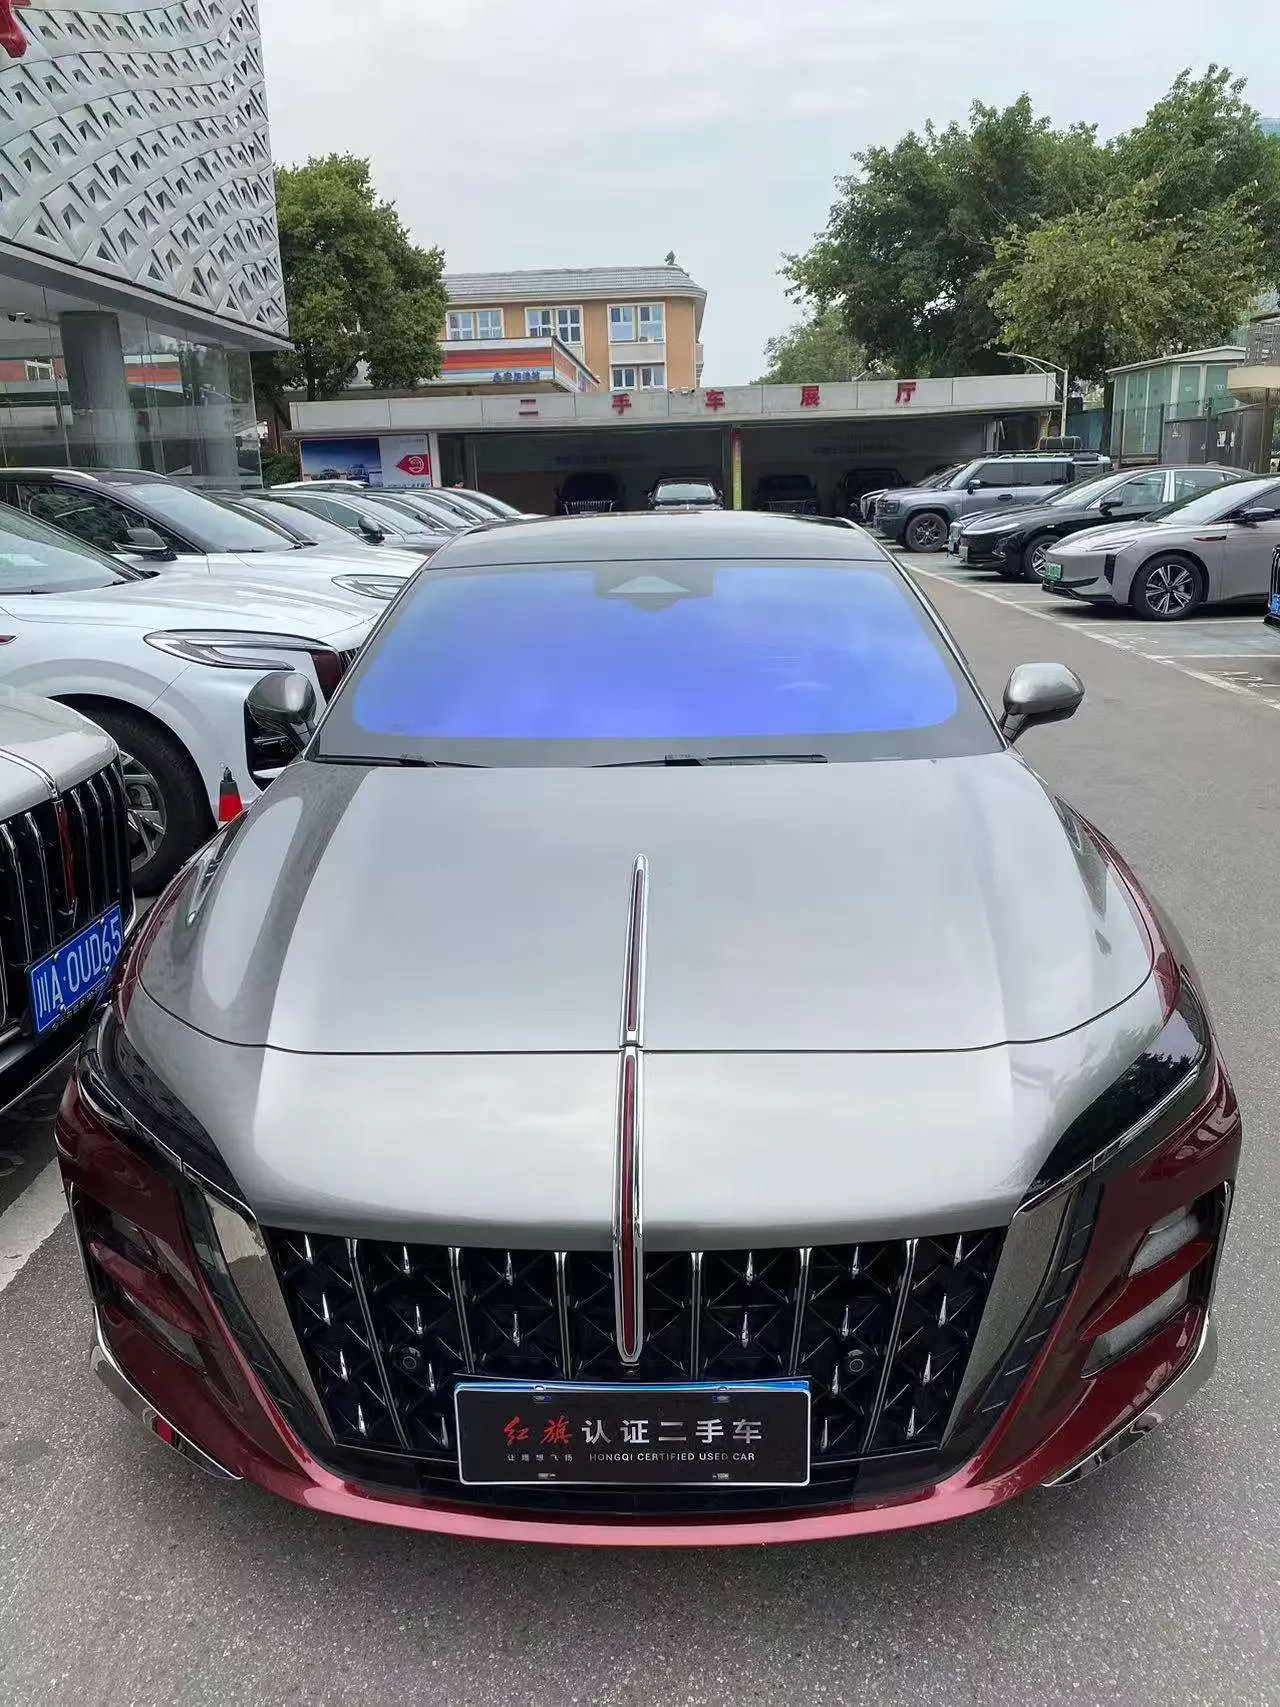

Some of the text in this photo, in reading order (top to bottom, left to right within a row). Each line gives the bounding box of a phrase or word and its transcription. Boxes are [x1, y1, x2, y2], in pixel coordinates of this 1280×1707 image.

[518, 382, 917, 416] 二手车展厅
[589, 1452, 755, 1462] HONGQI CERTIFIED USED CAR
